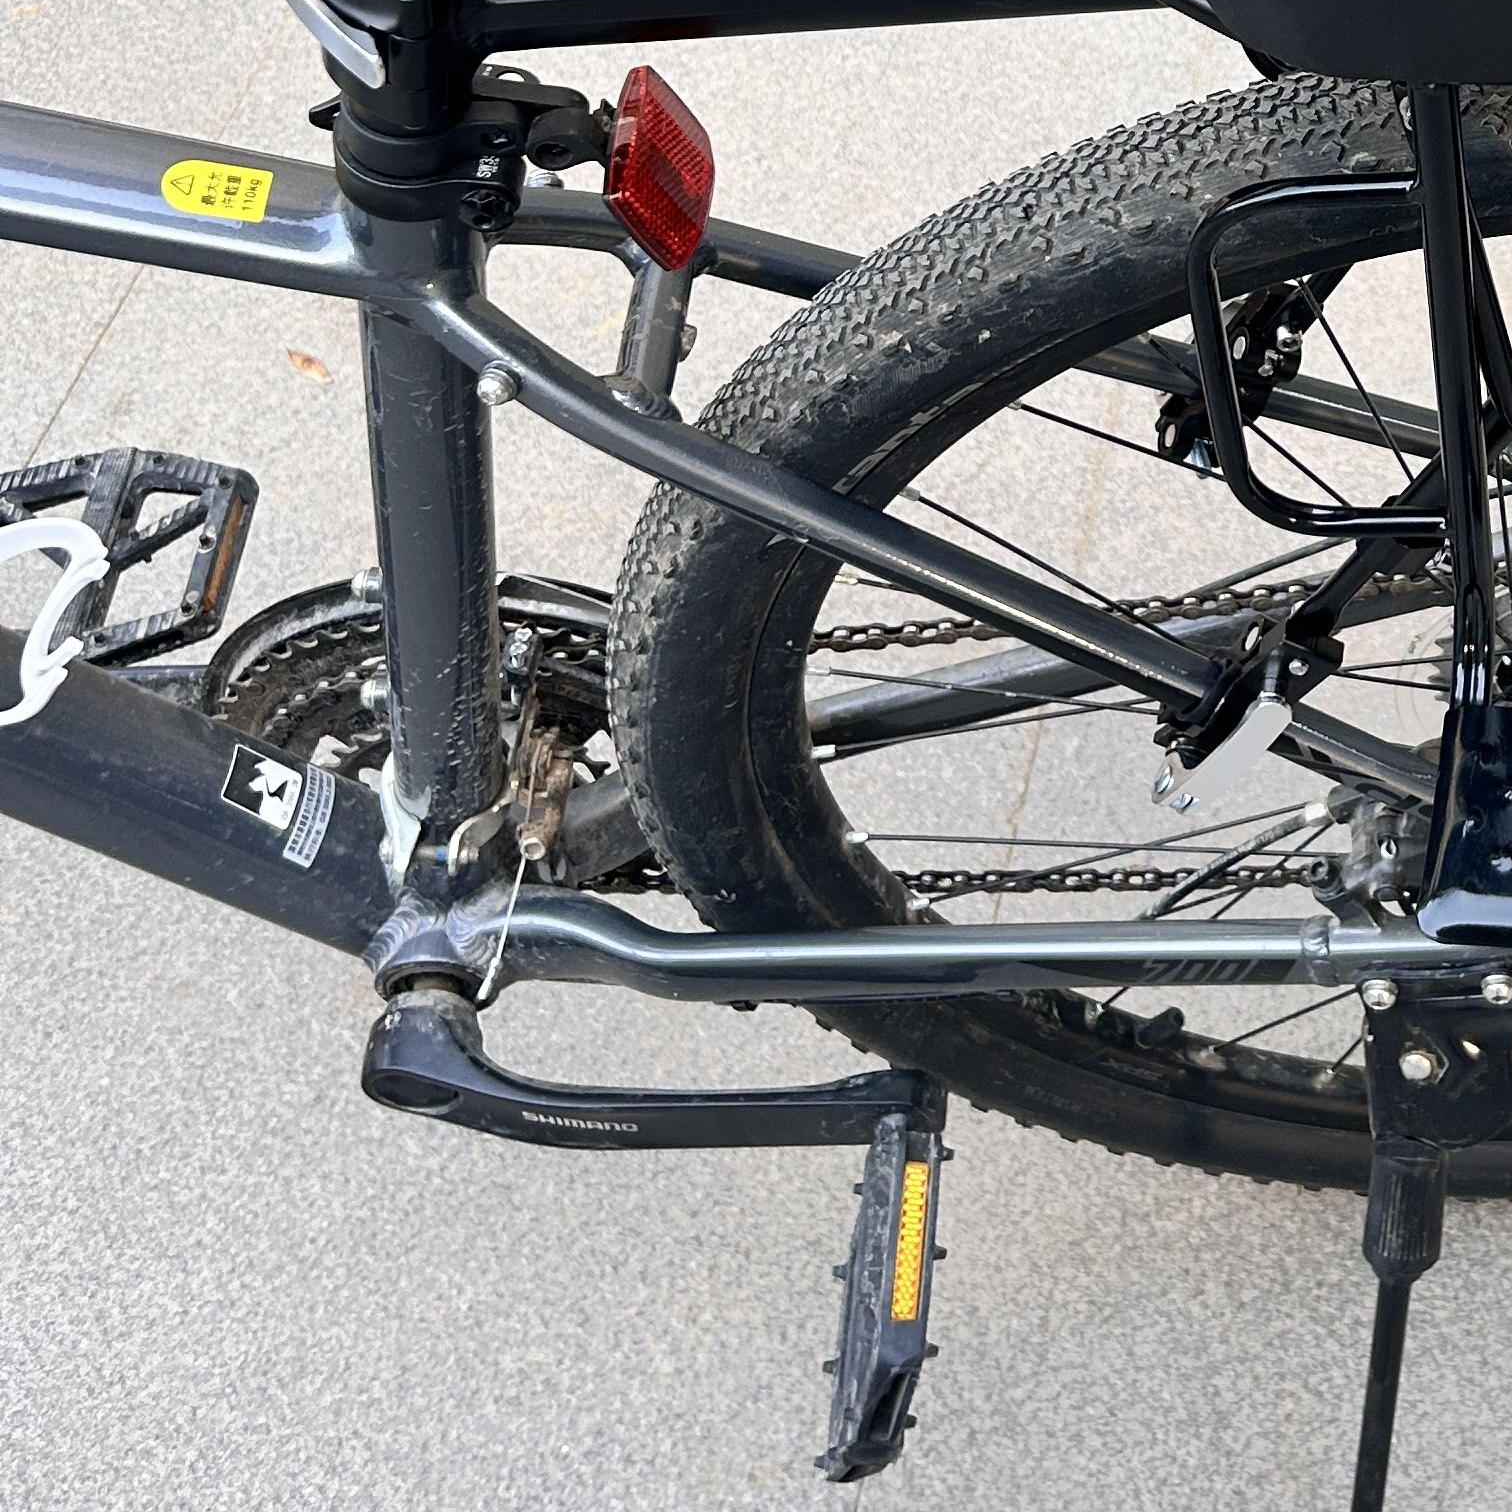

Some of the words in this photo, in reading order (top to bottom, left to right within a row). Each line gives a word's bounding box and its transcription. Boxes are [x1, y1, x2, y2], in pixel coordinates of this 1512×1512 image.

[201, 171, 223, 206] 最大允
[242, 178, 262, 210] 110kg
[521, 1111, 639, 1132] SHIMANO
